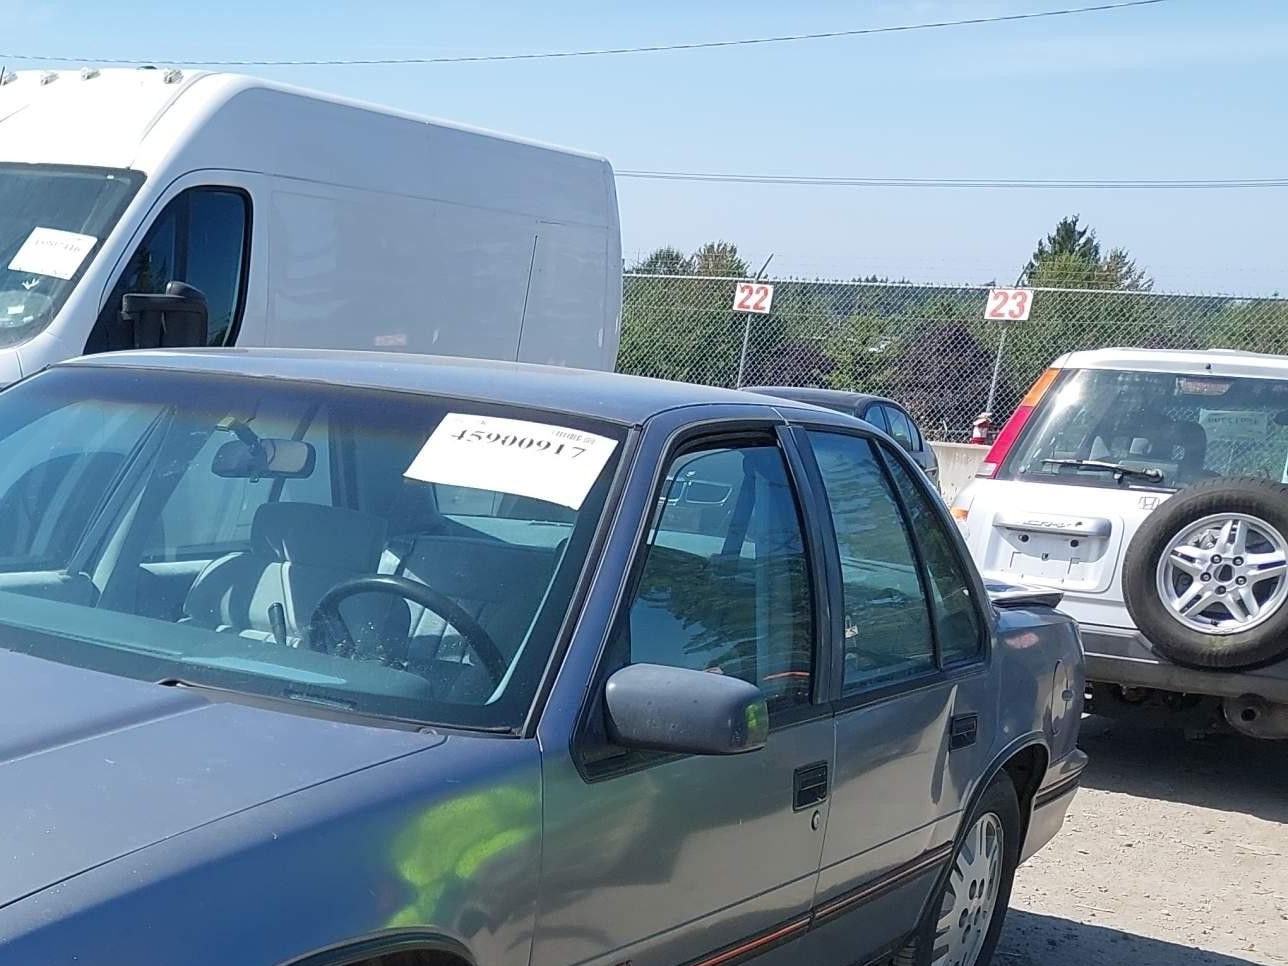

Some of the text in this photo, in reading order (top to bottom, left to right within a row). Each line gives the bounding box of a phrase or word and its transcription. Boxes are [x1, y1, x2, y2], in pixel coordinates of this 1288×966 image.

[738, 284, 768, 310] 22
[989, 291, 1028, 318] 23
[451, 429, 587, 458] 45900917
